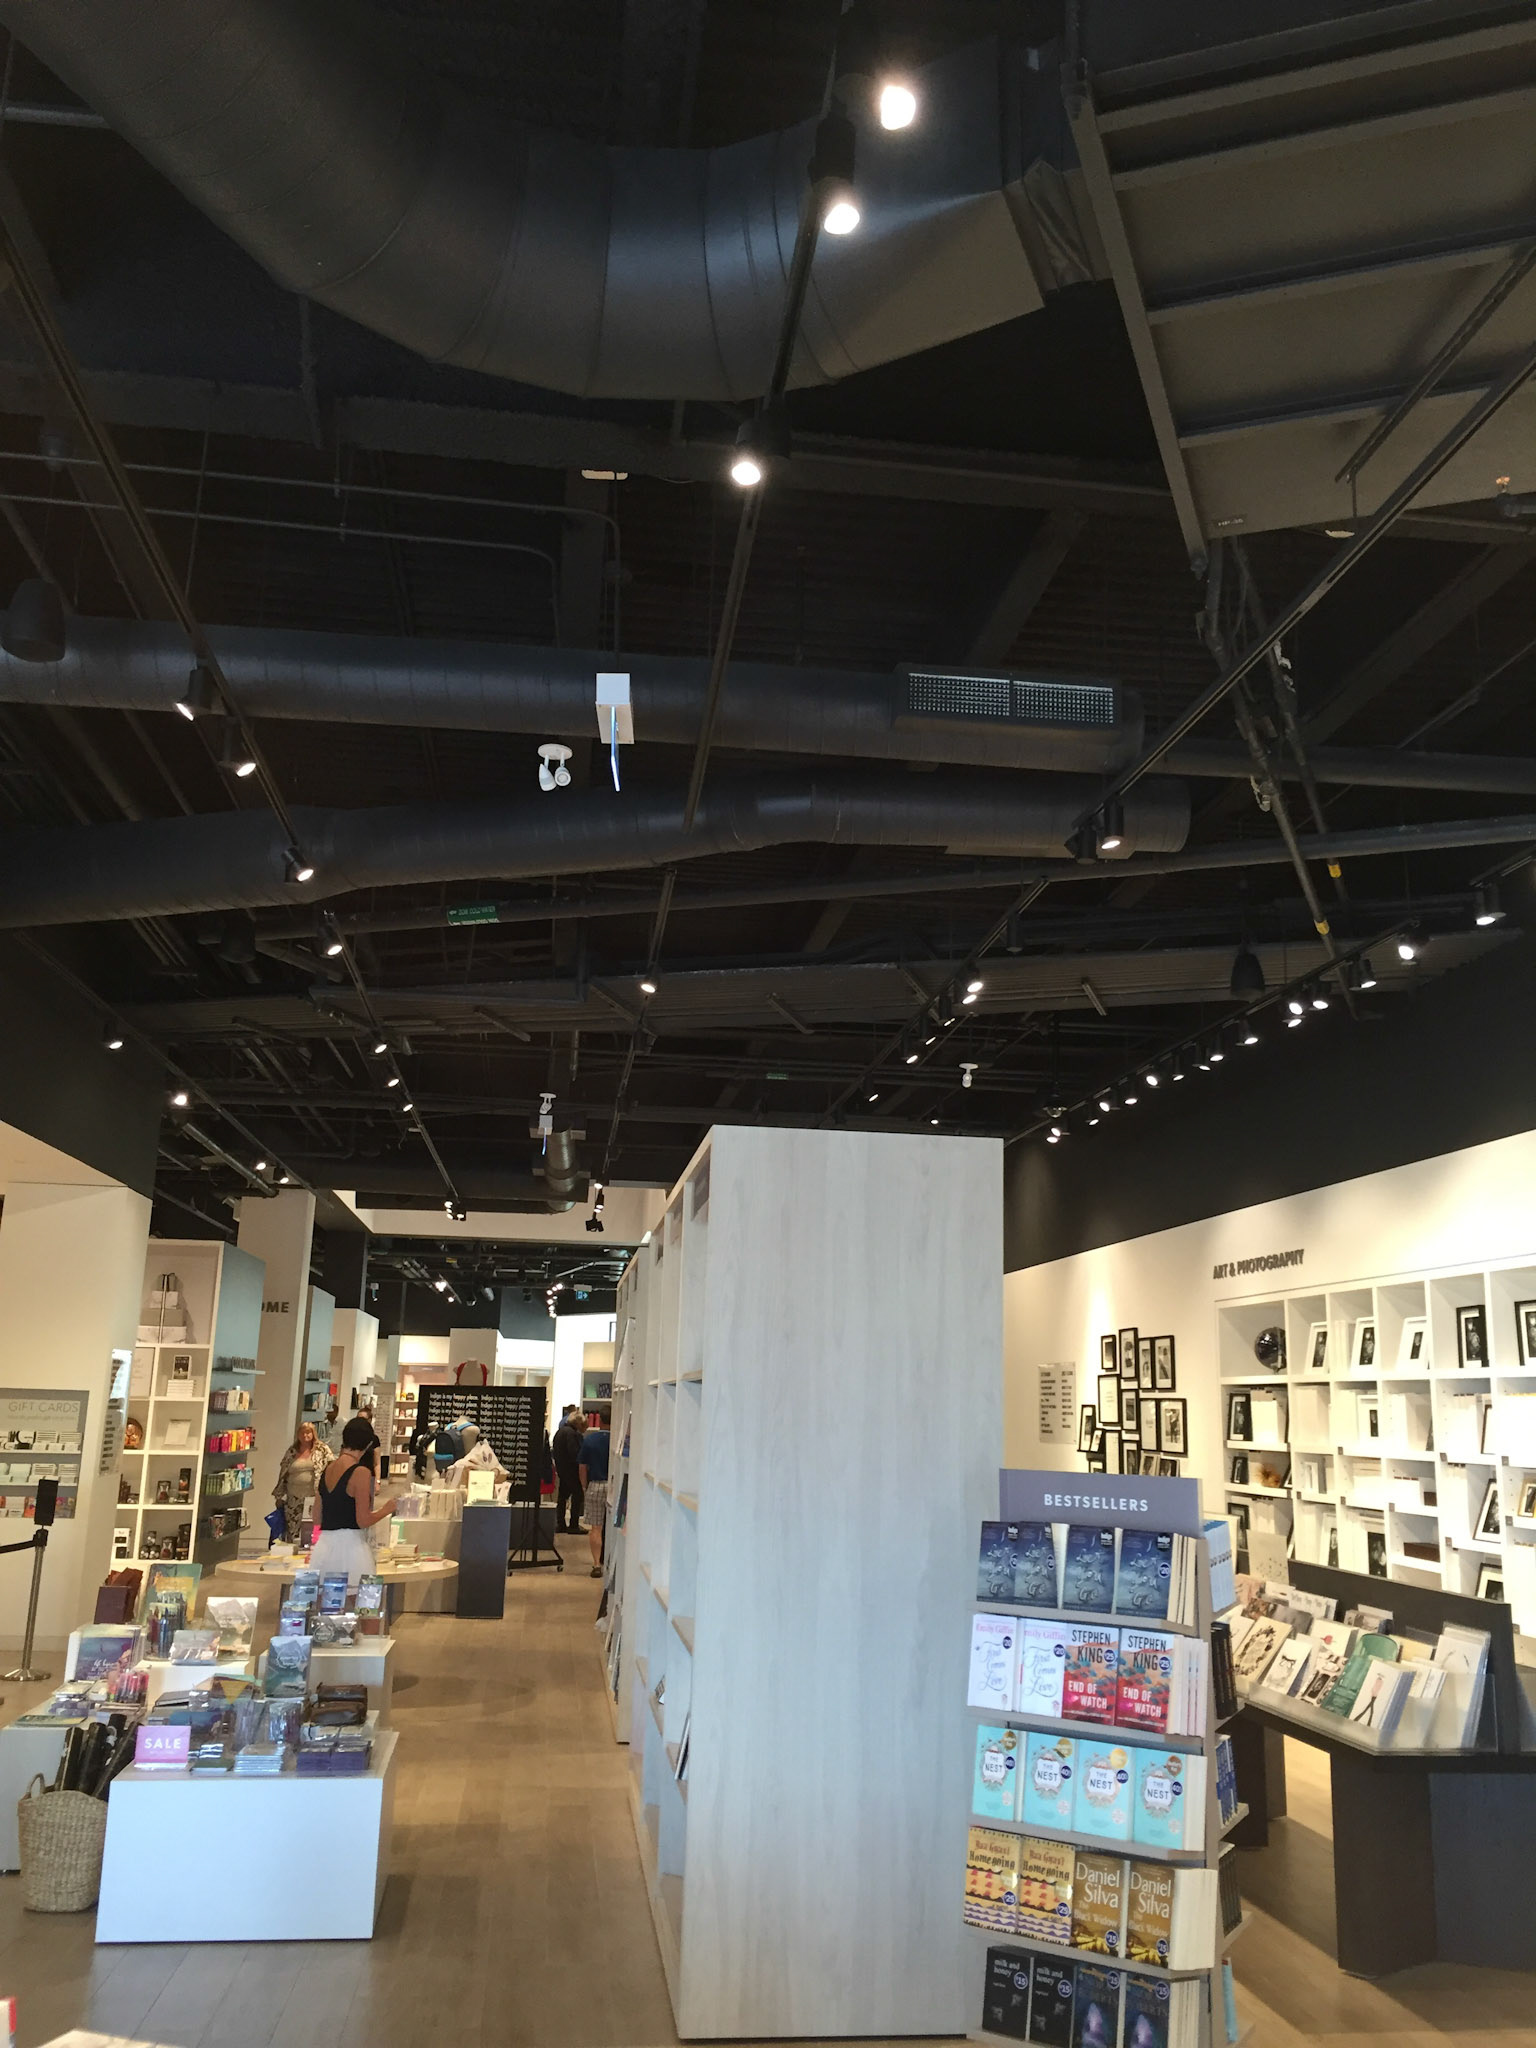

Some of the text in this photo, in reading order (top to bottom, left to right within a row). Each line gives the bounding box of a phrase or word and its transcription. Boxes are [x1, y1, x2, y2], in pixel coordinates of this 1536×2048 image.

[1213, 1248, 1304, 1279] ART & PHOTOGRAPHY
[8, 1401, 79, 1413] GIFT CARDS
[1044, 1493, 1148, 1512] BESTSELLERS
[1072, 1629, 1111, 1646] STEPHEN
[1128, 1634, 1167, 1652] STEPHEN
[1077, 1645, 1103, 1664] KING
[1133, 1651, 1159, 1671] KING
[1068, 1680, 1098, 1695] END OF
[1123, 1686, 1152, 1703] END OF
[1080, 1695, 1108, 1711] WATCH
[1134, 1702, 1162, 1718] WATCH
[144, 1737, 182, 1750] SALE
[985, 1763, 1003, 1773] NEST
[1037, 1770, 1058, 1782] NEST
[1089, 1779, 1113, 1790] NEST
[1147, 1789, 1169, 1800] NEST
[1076, 1861, 1120, 1888] Daniel
[1131, 1871, 1172, 1898] Daniel
[1083, 1882, 1119, 1909] Silva
[1138, 1891, 1170, 1919] Silva
[993, 1966, 1013, 1978] honey
[994, 1959, 1020, 1971] milk and
[1036, 1966, 1063, 1979] milk and
[1036, 1974, 1055, 1987] honey
